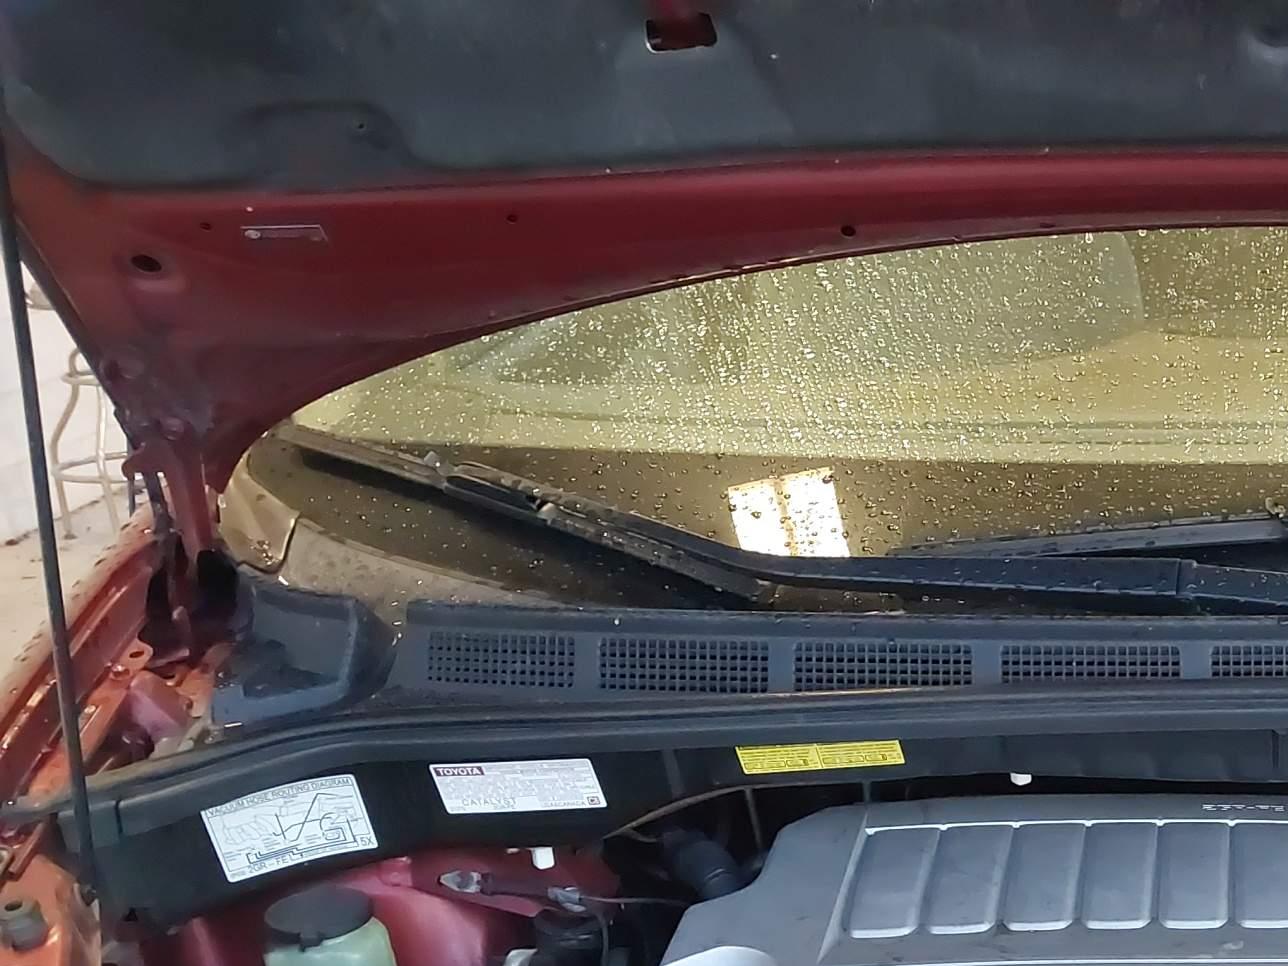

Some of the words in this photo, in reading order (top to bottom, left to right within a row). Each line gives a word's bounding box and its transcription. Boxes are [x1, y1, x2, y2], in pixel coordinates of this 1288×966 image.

[436, 767, 481, 776] TOYOTA
[208, 800, 245, 816] VACUUM
[245, 794, 271, 808] HOSE
[272, 783, 310, 799] ROUTING
[312, 777, 350, 791] DIAGRAM
[463, 797, 516, 807] CATALYST
[360, 838, 374, 847] 5X
